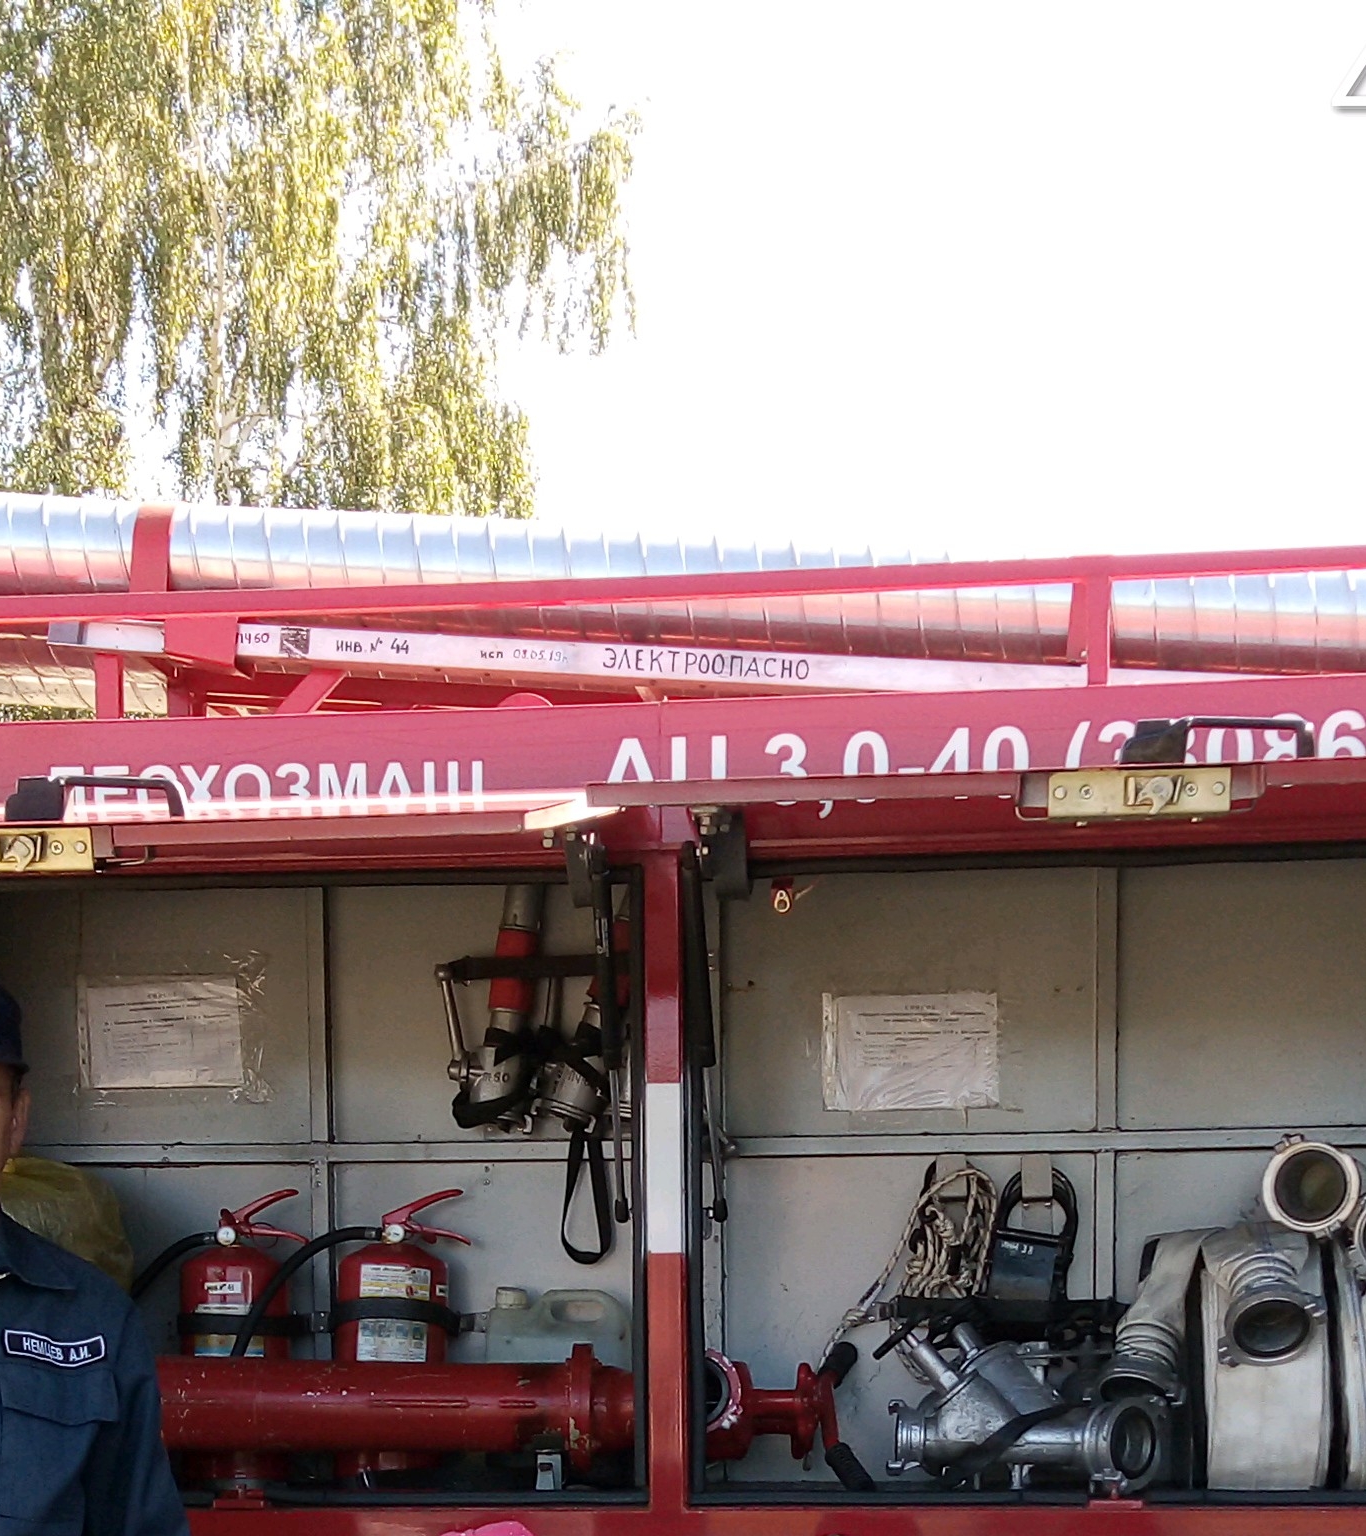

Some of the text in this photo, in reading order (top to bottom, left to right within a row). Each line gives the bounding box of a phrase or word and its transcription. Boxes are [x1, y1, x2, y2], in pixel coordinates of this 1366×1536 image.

[389, 637, 410, 656] 44
[601, 646, 811, 682] ЭЛЕКТРООПАСНО
[22, 1336, 64, 1360] НЕМЦЕВ
